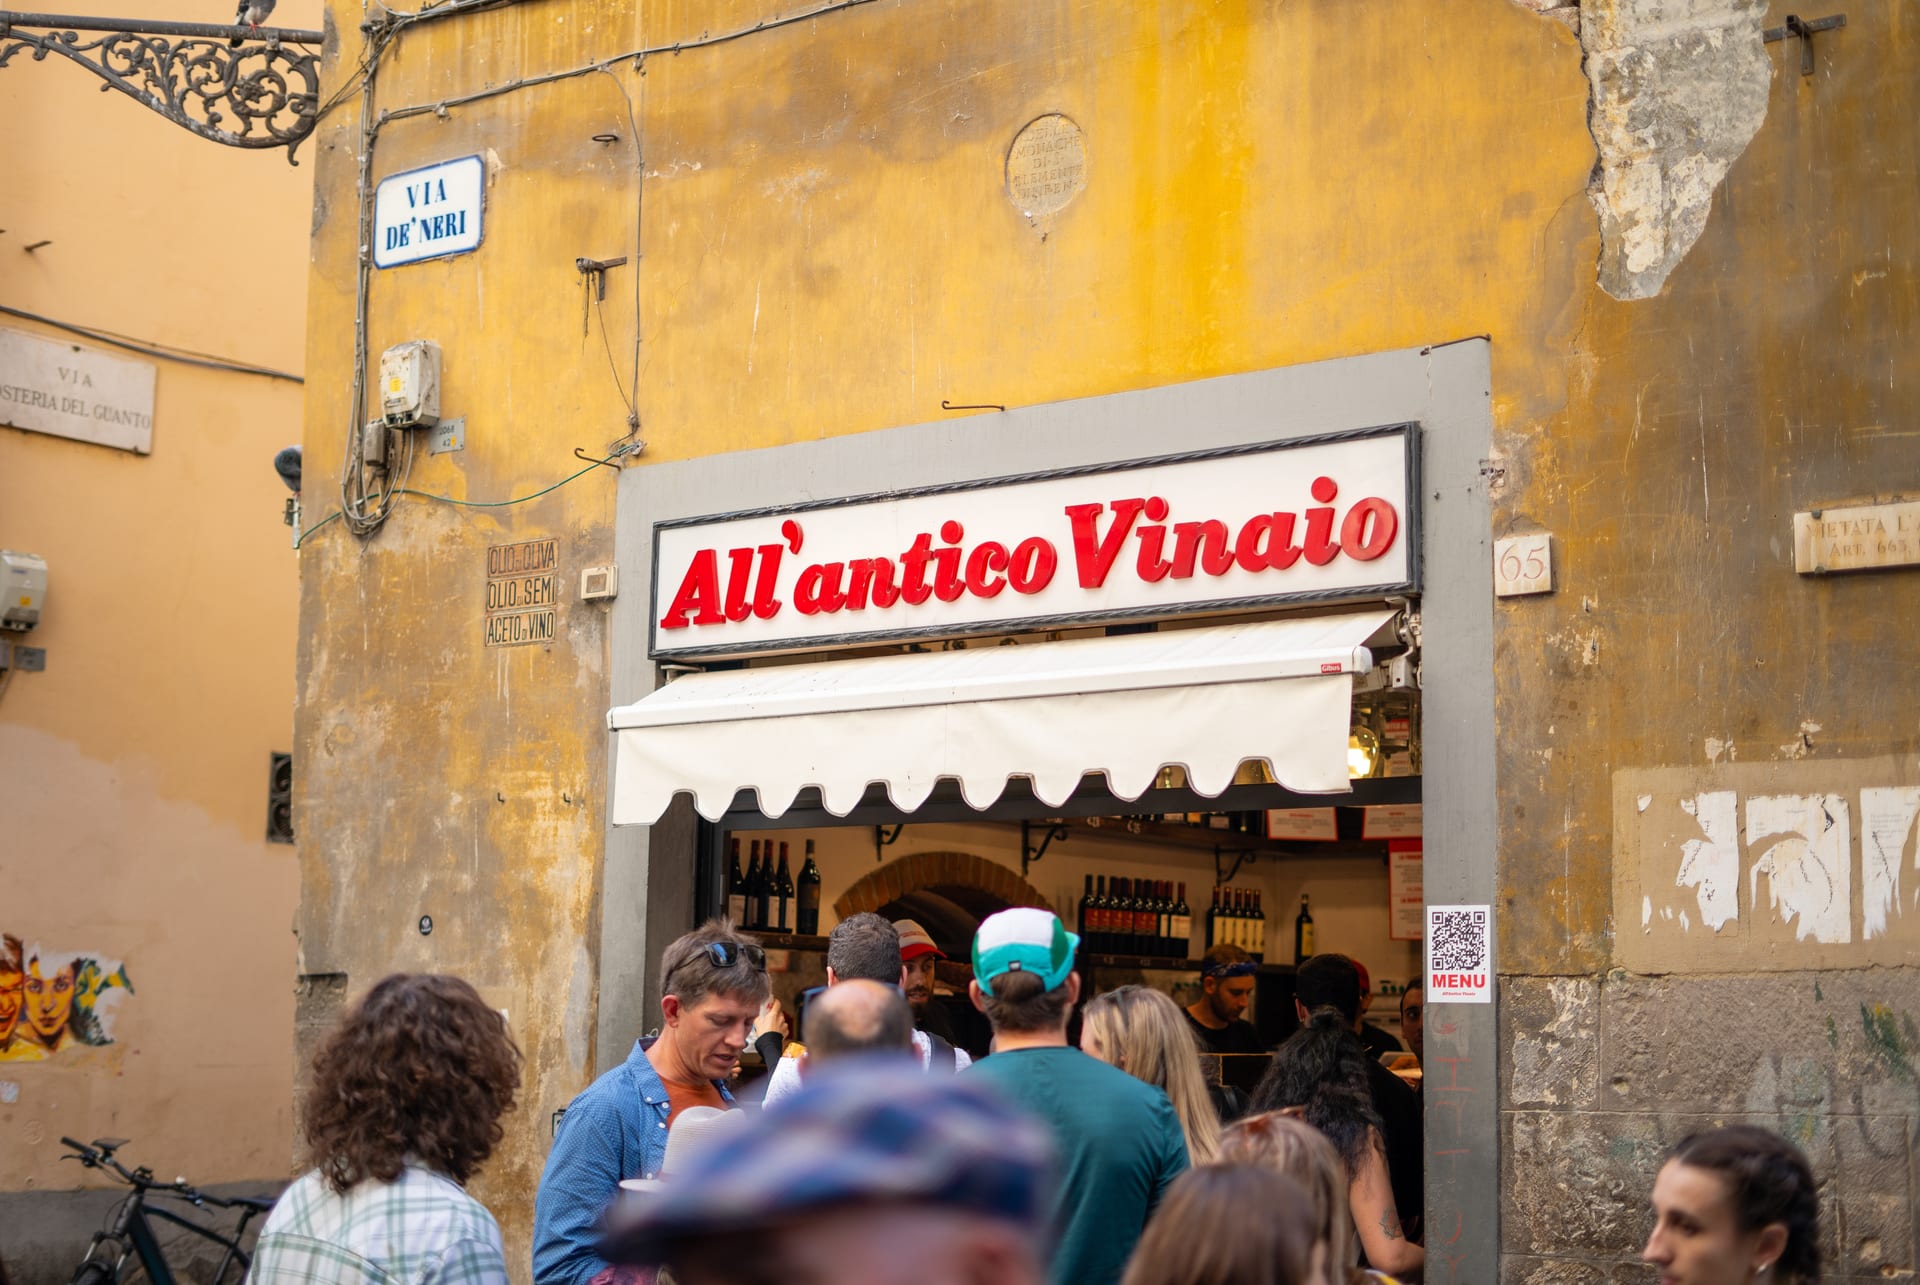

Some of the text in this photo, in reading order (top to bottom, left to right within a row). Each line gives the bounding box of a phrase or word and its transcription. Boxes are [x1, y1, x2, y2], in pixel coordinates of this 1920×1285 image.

[407, 179, 447, 208] VIA
[58, 367, 92, 388] VIA
[61, 398, 89, 417] DEL
[93, 404, 150, 430] GUANTO
[1806, 519, 1887, 538] VIETATA
[490, 546, 515, 574] OLIO
[523, 541, 556, 571] OLIVA
[660, 476, 1398, 629] All'antico Vinaio
[1500, 543, 1545, 581] 65
[488, 581, 517, 608] OLIO
[524, 576, 556, 605] SEMI
[487, 615, 521, 643] ACETO
[528, 612, 554, 640] VINO
[1432, 974, 1485, 988] MENU
